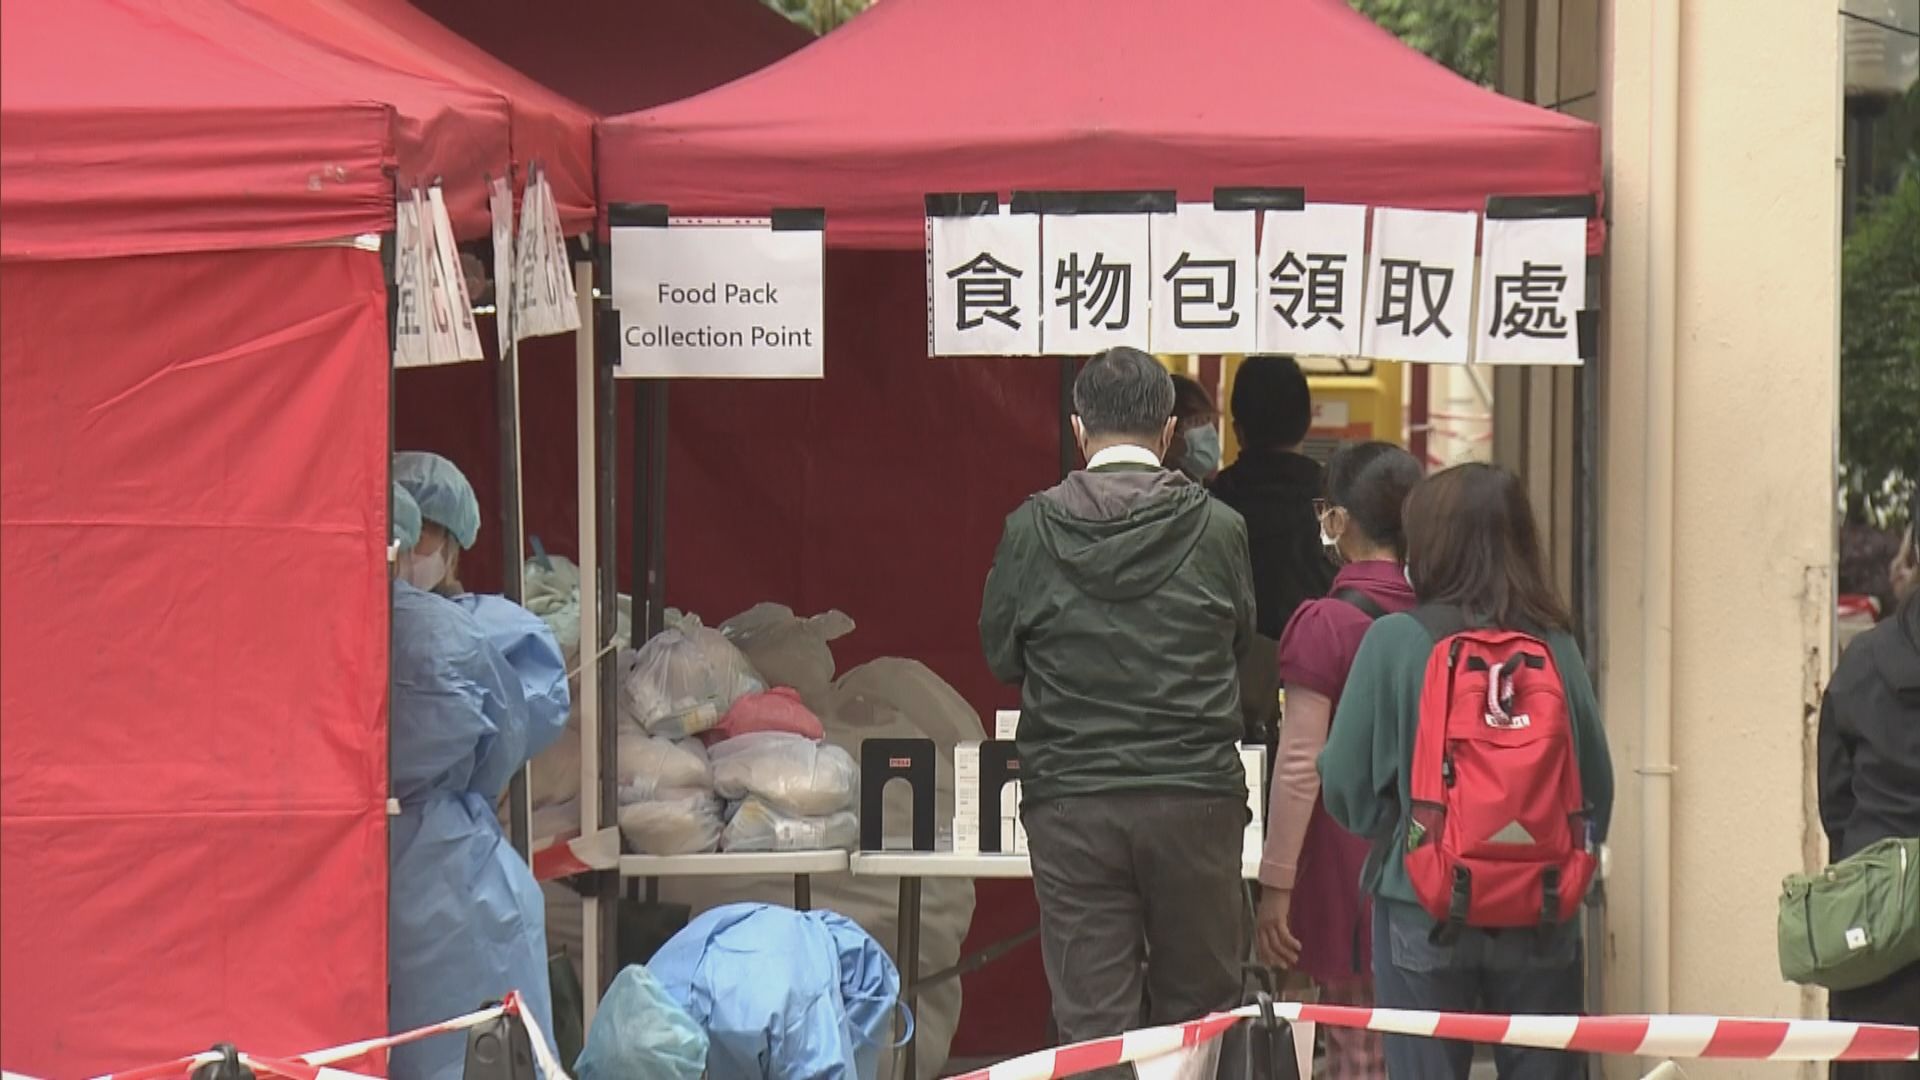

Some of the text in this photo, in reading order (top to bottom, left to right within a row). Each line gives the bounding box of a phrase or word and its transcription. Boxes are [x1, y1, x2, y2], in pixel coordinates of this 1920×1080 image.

[658, 282, 778, 304] Food Pack
[946, 251, 1569, 339] 食物包領取處
[624, 325, 812, 347] Collection Point
